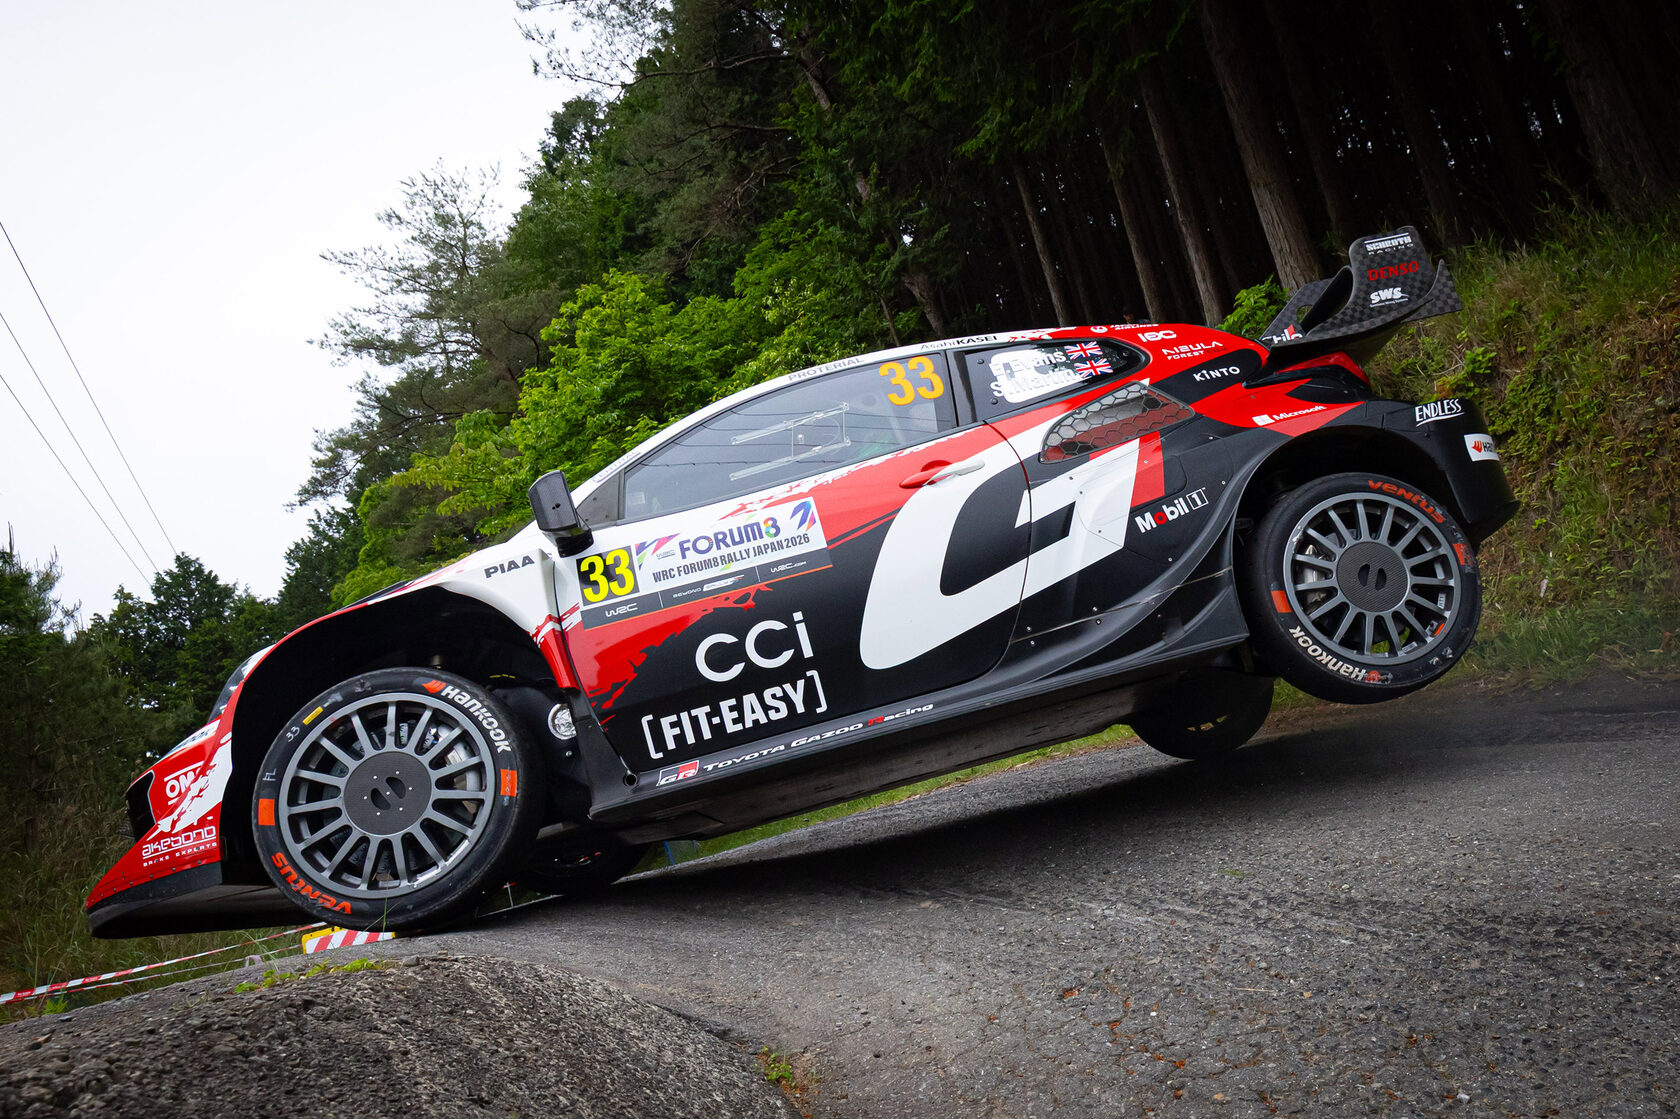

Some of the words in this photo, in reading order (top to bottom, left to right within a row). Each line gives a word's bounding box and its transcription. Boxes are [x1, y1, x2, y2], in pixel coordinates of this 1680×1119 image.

[1365, 236, 1412, 251] SCHROTH
[1368, 260, 1419, 281] DENSO
[1370, 287, 1402, 304] SWS
[787, 357, 864, 381] PROTERIAL
[878, 355, 945, 405] 33
[1193, 366, 1241, 381] KINTO
[1272, 405, 1327, 420] Microsoft
[1414, 399, 1462, 421] ENDLESS
[1134, 497, 1190, 534] Mobil
[678, 517, 781, 560] FORUM8
[484, 555, 535, 579] PIAA
[652, 568, 676, 583] WRC
[676, 556, 720, 577] FORUM8
[719, 548, 751, 566] RALLY
[752, 540, 785, 557] JAPAN
[784, 533, 810, 549] 2026
[580, 548, 636, 604] 33
[605, 603, 639, 618] WRC
[1288, 626, 1366, 682] Hankook
[440, 685, 512, 753] Hankook
[285, 726, 300, 742] 33
[658, 768, 698, 786] GR
[703, 744, 786, 771] TOYOTA
[143, 855, 170, 867] BRAKE
[175, 842, 218, 858] EXPERTS
